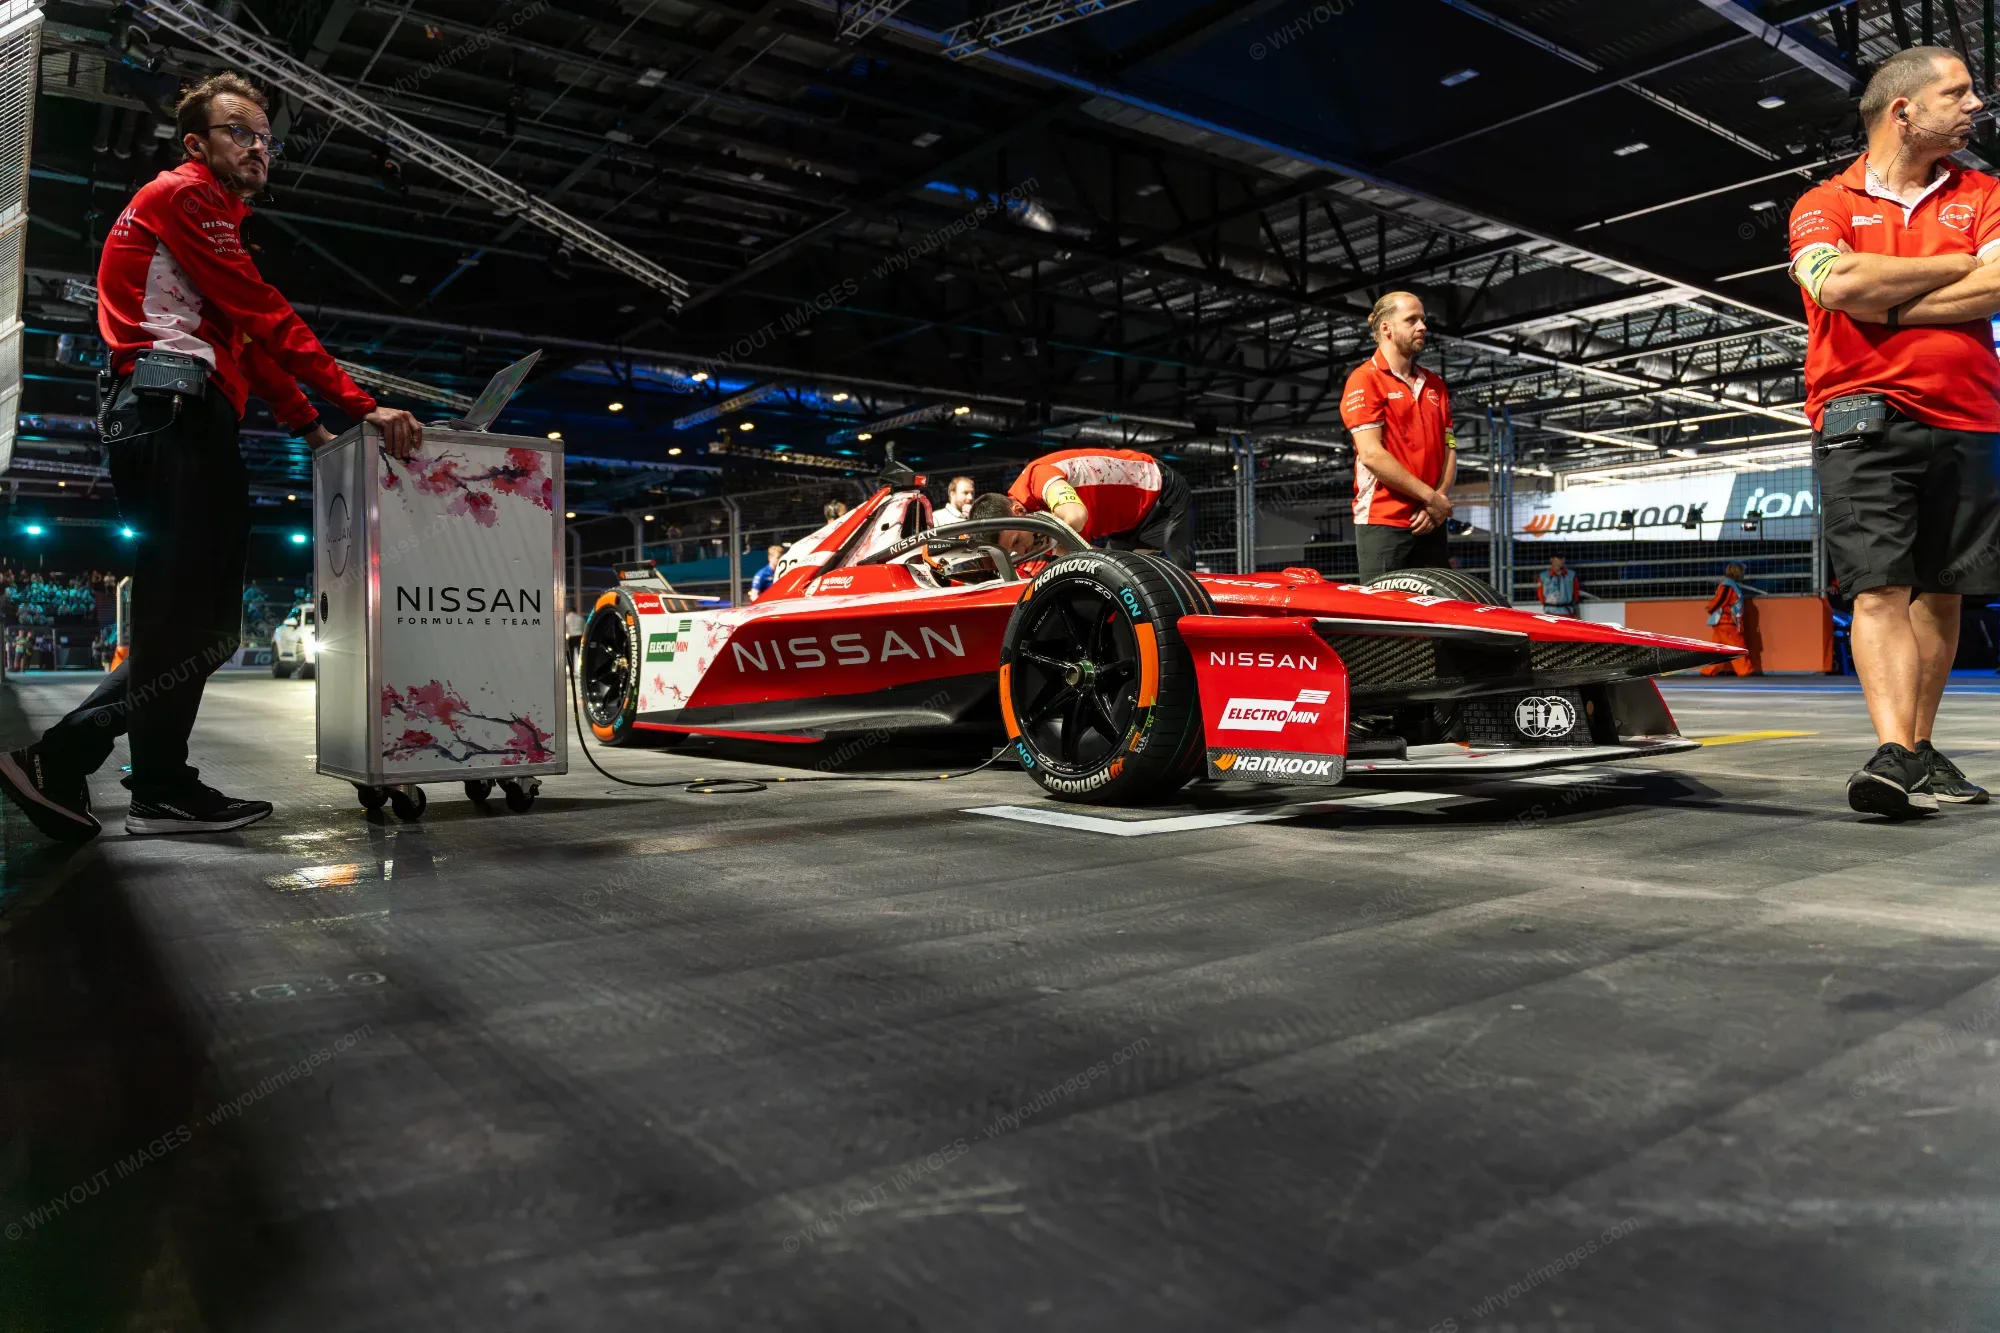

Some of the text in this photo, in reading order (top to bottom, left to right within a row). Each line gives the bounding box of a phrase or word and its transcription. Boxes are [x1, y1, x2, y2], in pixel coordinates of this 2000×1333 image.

[1938, 213, 1976, 222] NISSAN
[890, 528, 937, 555] NISSAN
[397, 586, 541, 613] NISSAN
[397, 617, 474, 625] FORMULA
[502, 618, 541, 626] TEAM
[731, 624, 966, 673] NISSAN
[1210, 651, 1318, 671] NISSAN
